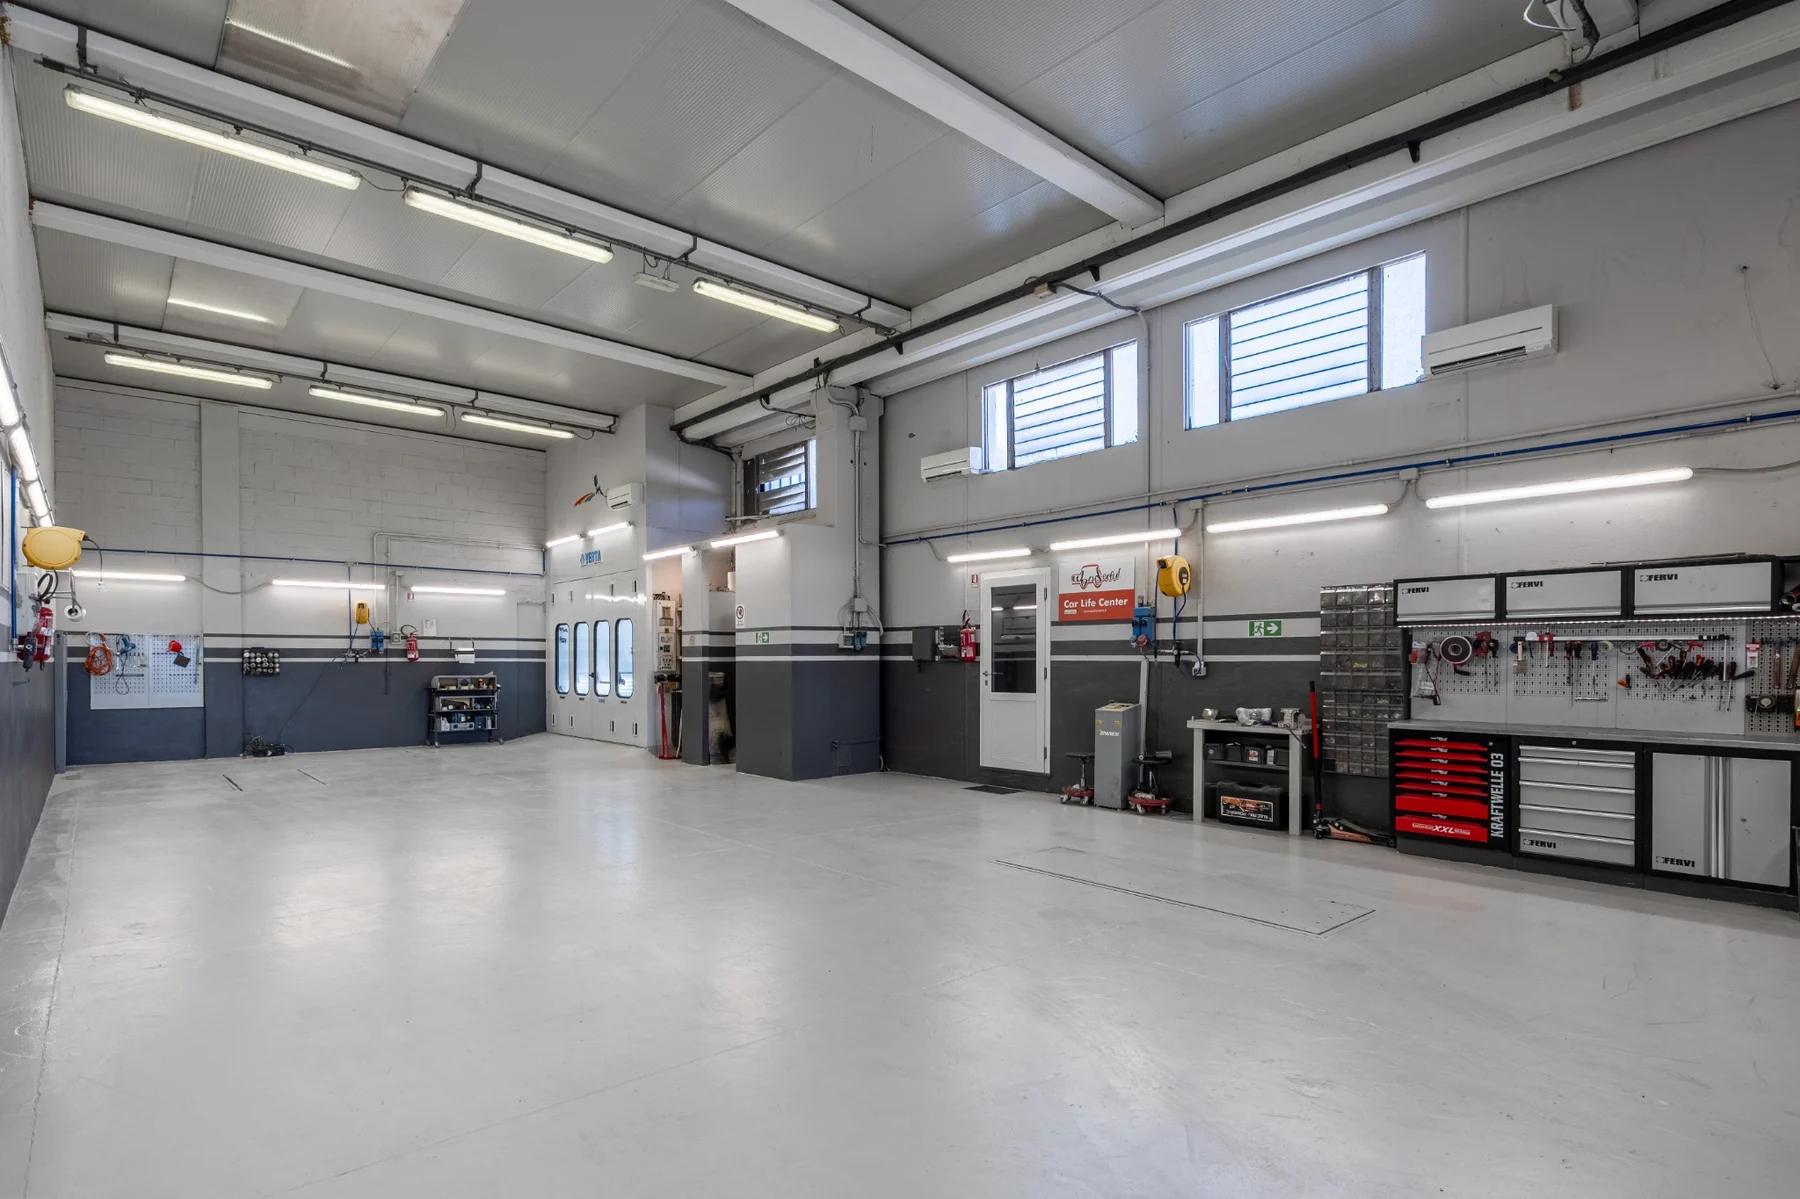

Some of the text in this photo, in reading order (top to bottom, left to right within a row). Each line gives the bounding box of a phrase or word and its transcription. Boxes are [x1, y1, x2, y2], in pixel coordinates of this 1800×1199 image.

[1064, 598, 1128, 608] Car Life Center
[1490, 752, 1504, 838] KRAFTWELLE 03
[1432, 825, 1455, 834] XXL
[1530, 840, 1556, 848] FERVI
[1664, 857, 1695, 867] FERVI
